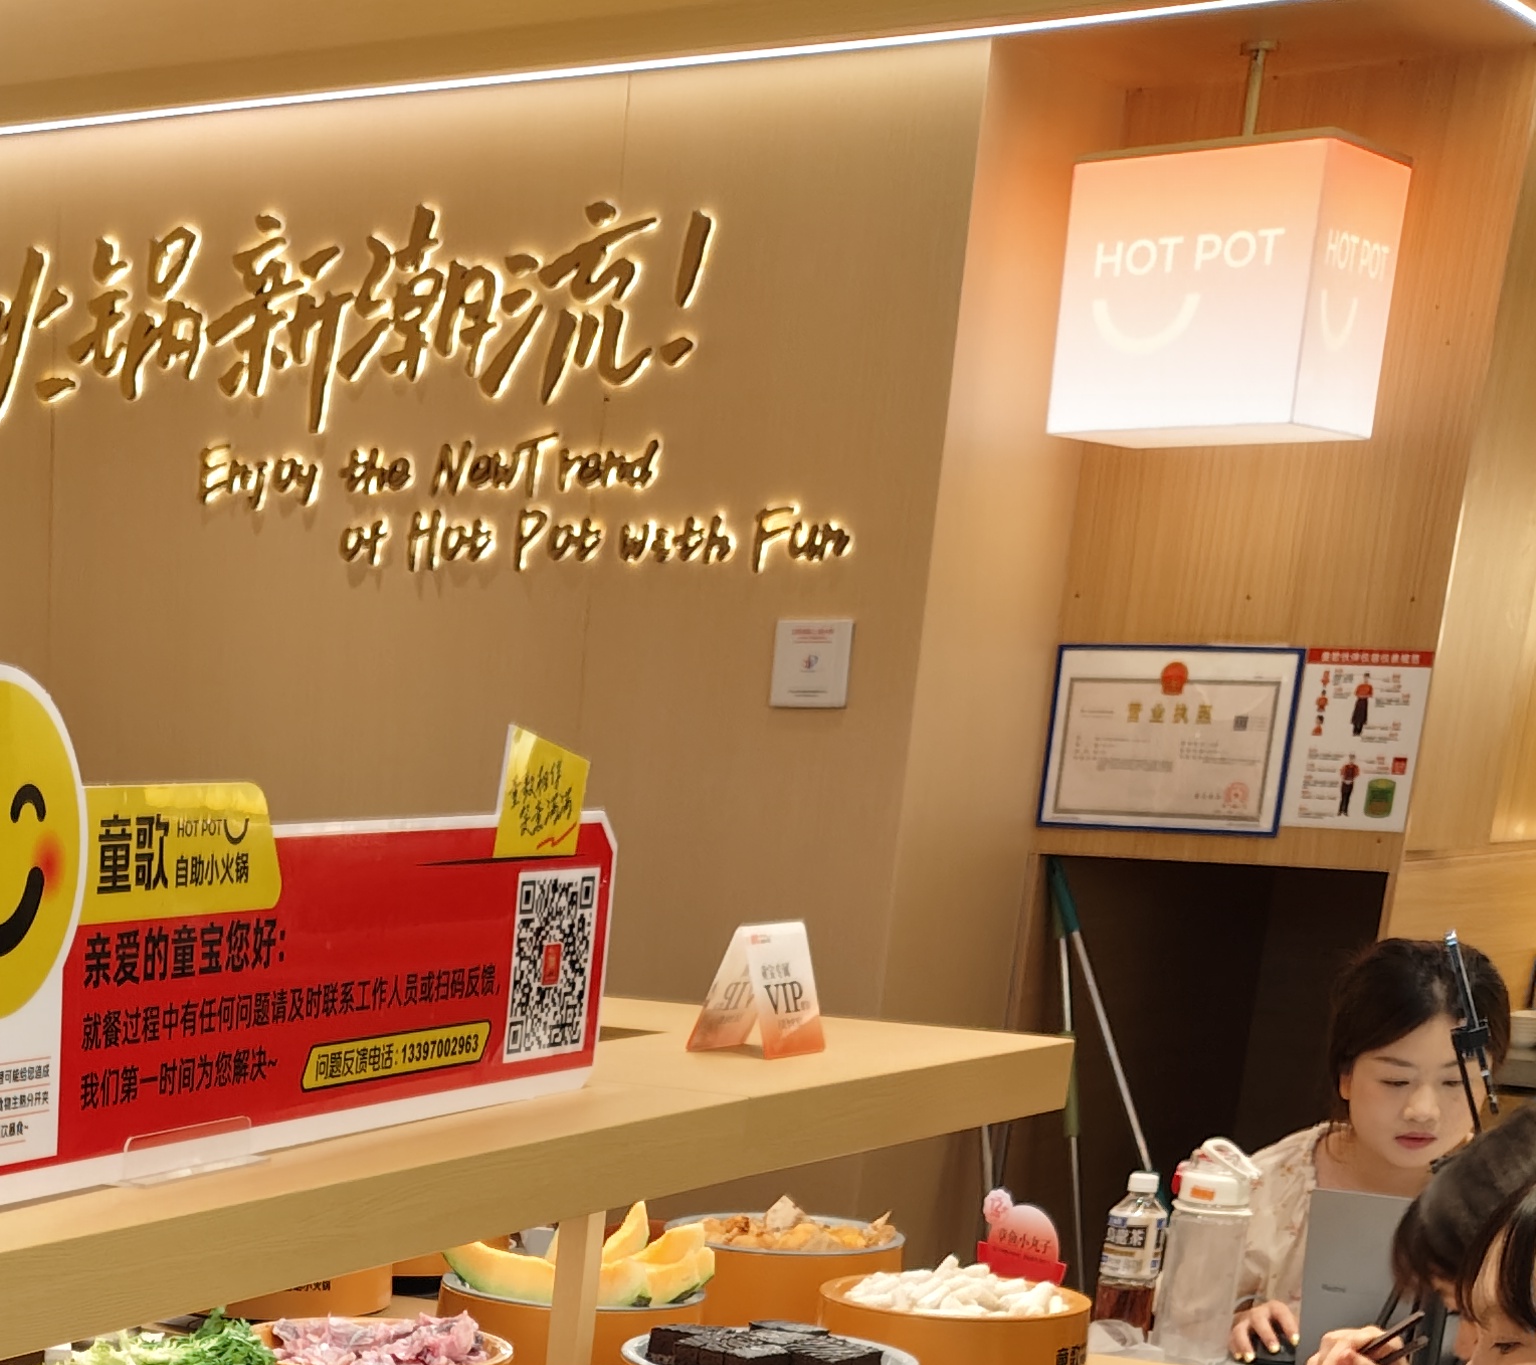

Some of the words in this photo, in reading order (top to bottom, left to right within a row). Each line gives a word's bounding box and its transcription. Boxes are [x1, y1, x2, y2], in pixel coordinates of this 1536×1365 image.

[1094, 236, 1184, 279] HOT
[1193, 227, 1286, 272] POT
[1324, 229, 1361, 271] HOT
[1359, 238, 1390, 282] POT
[200, 443, 320, 510] Enjoy
[339, 446, 414, 496] the
[339, 518, 388, 566] of
[406, 508, 494, 572] Hot
[514, 506, 602, 572] Pot
[618, 514, 736, 564] with
[751, 506, 856, 574] Fun
[97, 813, 170, 895] 童歌
[177, 818, 200, 838] HOT
[201, 817, 224, 837] POT
[174, 852, 249, 889] 自助小火锅
[83, 918, 287, 989] 亲爱的童宝您好：
[81, 963, 501, 1052] 就餐过程中有任何问题请及时联系工作人员或扫码反馈，
[763, 980, 804, 1015] VIP
